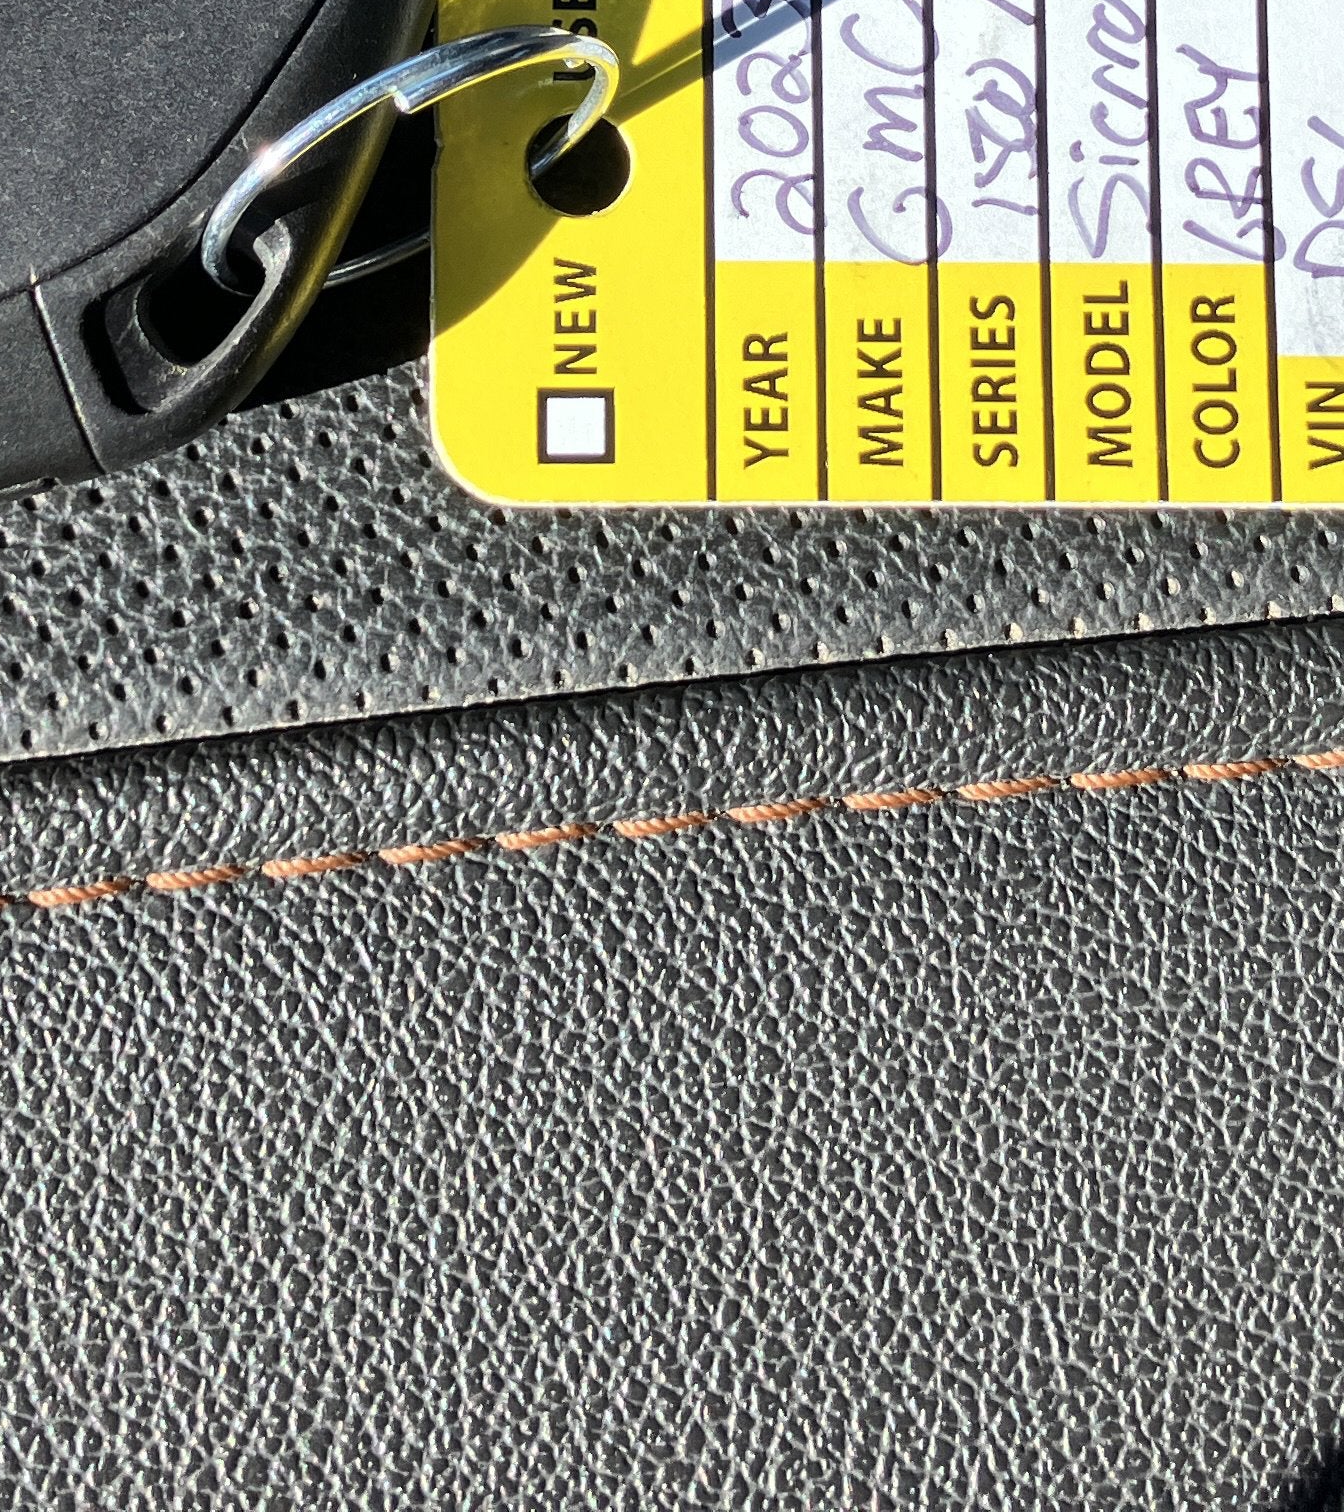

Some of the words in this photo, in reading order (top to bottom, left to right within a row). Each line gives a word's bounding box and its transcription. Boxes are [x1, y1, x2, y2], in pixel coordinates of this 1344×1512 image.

[1175, 44, 1286, 264] GREY
[553, 258, 597, 375] NEW
[742, 331, 789, 469] YEAR
[857, 317, 903, 467] MAKE
[970, 294, 1019, 468] SERIES
[1083, 280, 1133, 468] MODEL
[1190, 294, 1241, 469] COLOR
